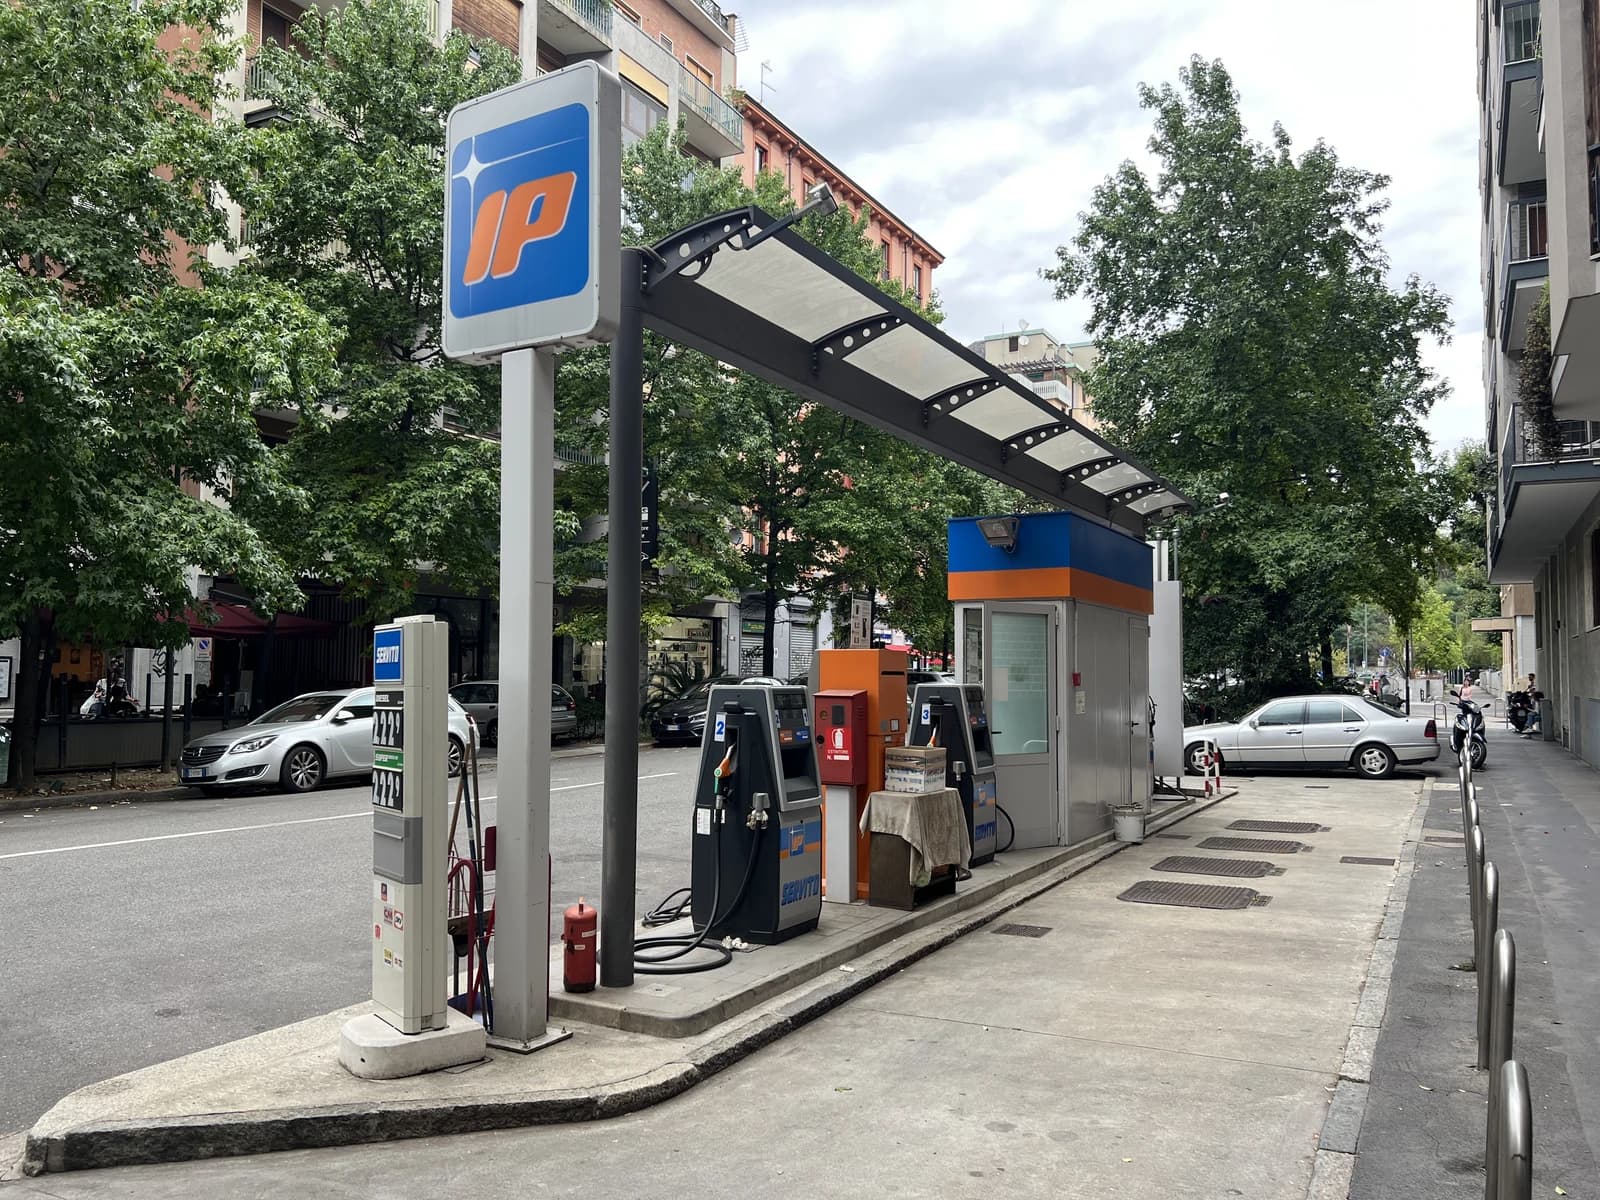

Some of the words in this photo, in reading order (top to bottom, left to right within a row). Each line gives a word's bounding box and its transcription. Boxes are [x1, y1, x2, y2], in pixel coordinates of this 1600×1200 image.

[463, 171, 577, 286] IP
[376, 645, 400, 664] SERVITO
[923, 709, 930, 720] 3
[716, 721, 725, 735] 2
[781, 874, 820, 906] SERVITO
